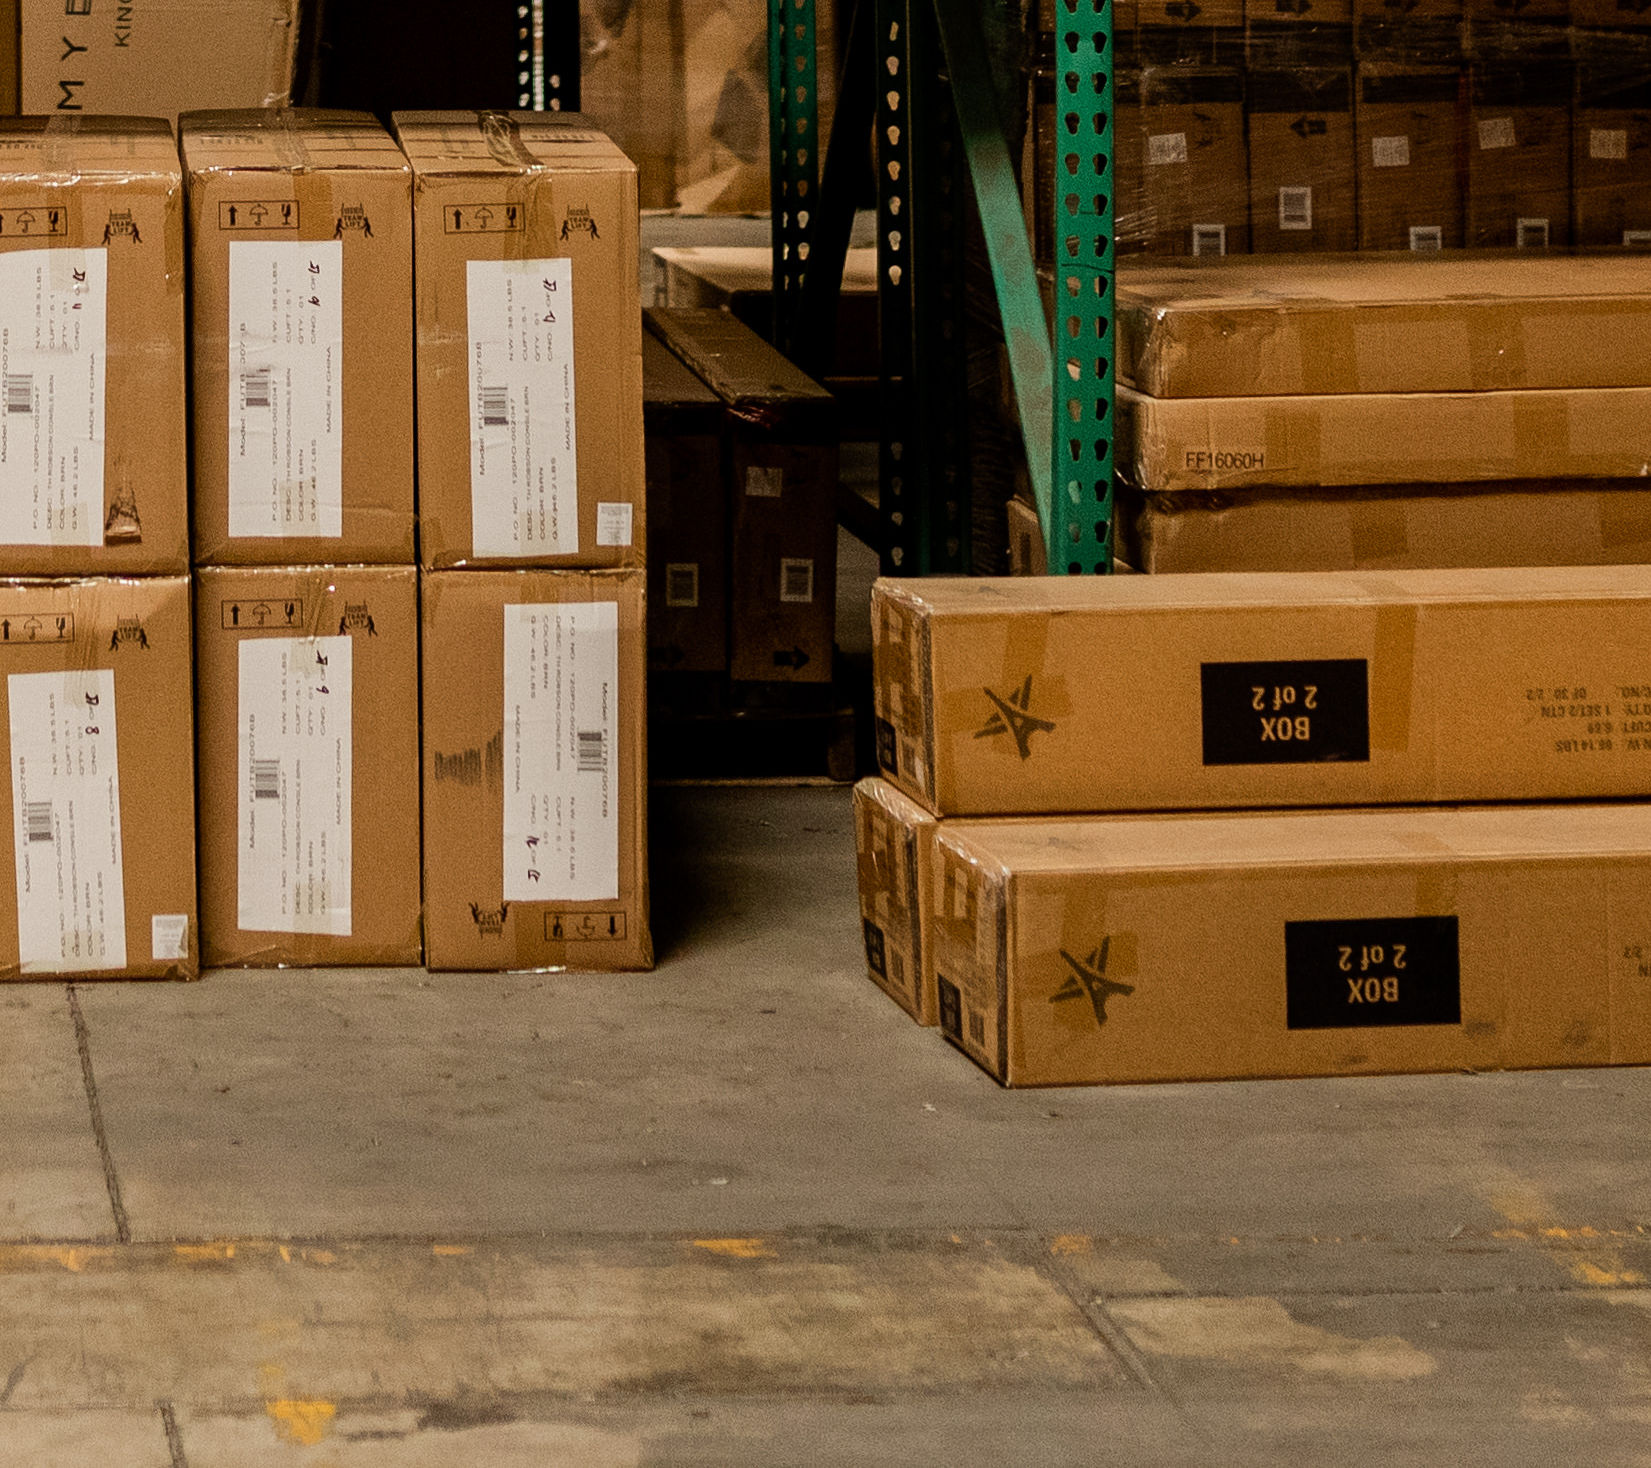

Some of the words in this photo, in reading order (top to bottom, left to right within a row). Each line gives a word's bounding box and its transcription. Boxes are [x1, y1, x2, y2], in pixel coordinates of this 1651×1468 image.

[1186, 451, 1264, 470] FF16060H
[1251, 686, 1265, 711] 2
[1272, 686, 1296, 711] of
[1304, 685, 1318, 709] 2
[1260, 716, 1310, 741] BOX
[1338, 945, 1352, 971] 2
[1360, 945, 1384, 971] of
[1393, 944, 1407, 969] 2
[1347, 977, 1399, 1003] BOX
